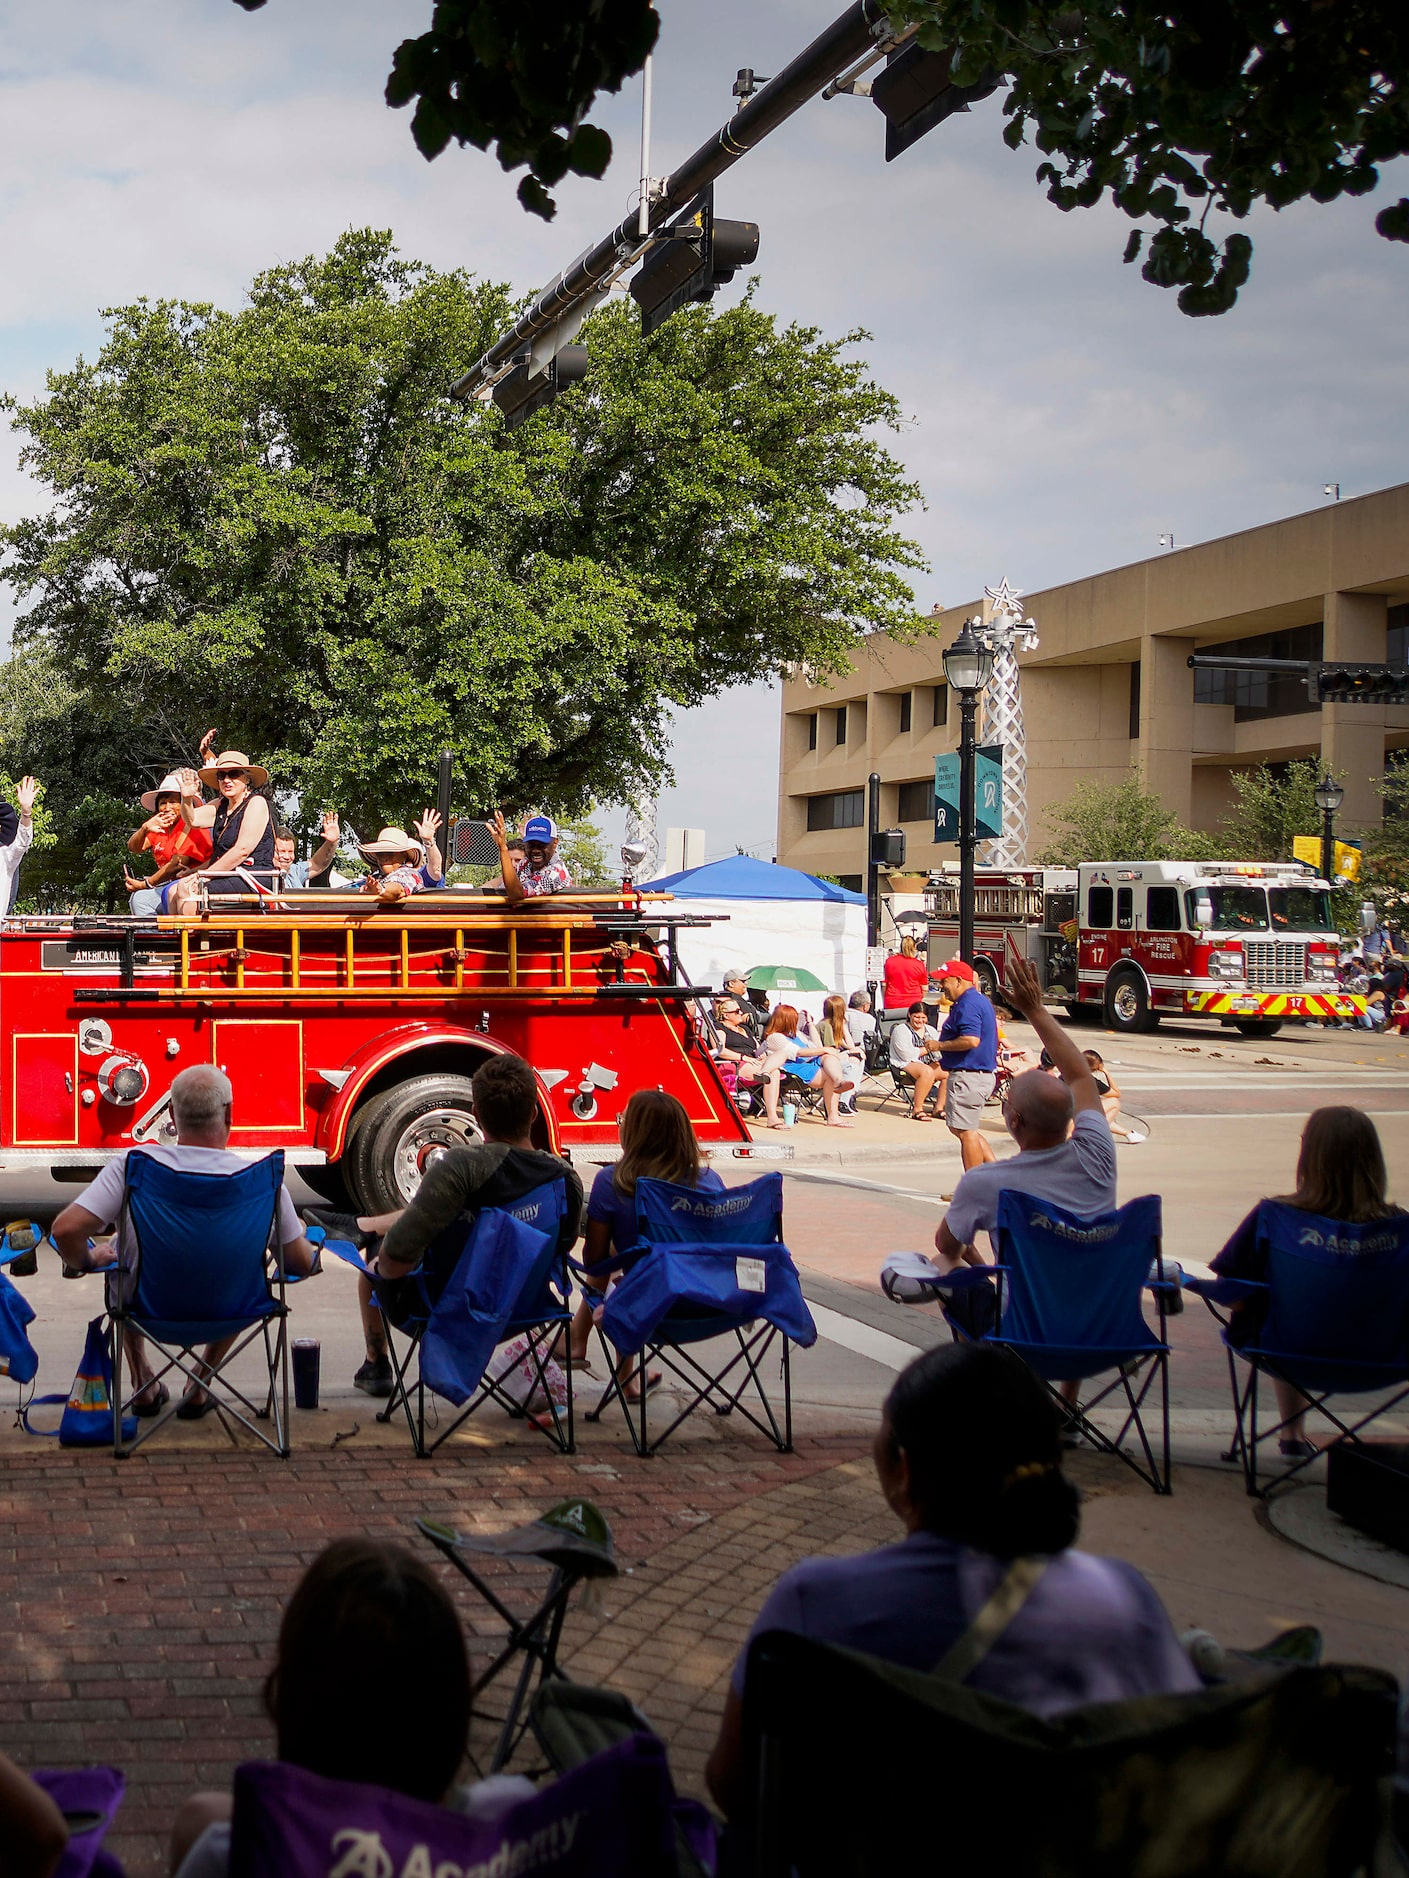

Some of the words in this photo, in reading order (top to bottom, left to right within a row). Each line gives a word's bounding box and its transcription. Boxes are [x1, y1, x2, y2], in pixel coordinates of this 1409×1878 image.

[1150, 936, 1178, 944] ARLINGTON
[1156, 943, 1171, 952] FIRE
[75, 949, 117, 961] AMERICAN
[1092, 947, 1104, 963] 17
[1151, 951, 1176, 959] RESCUE
[1290, 997, 1303, 1007] 17
[694, 1195, 753, 1213] Academy
